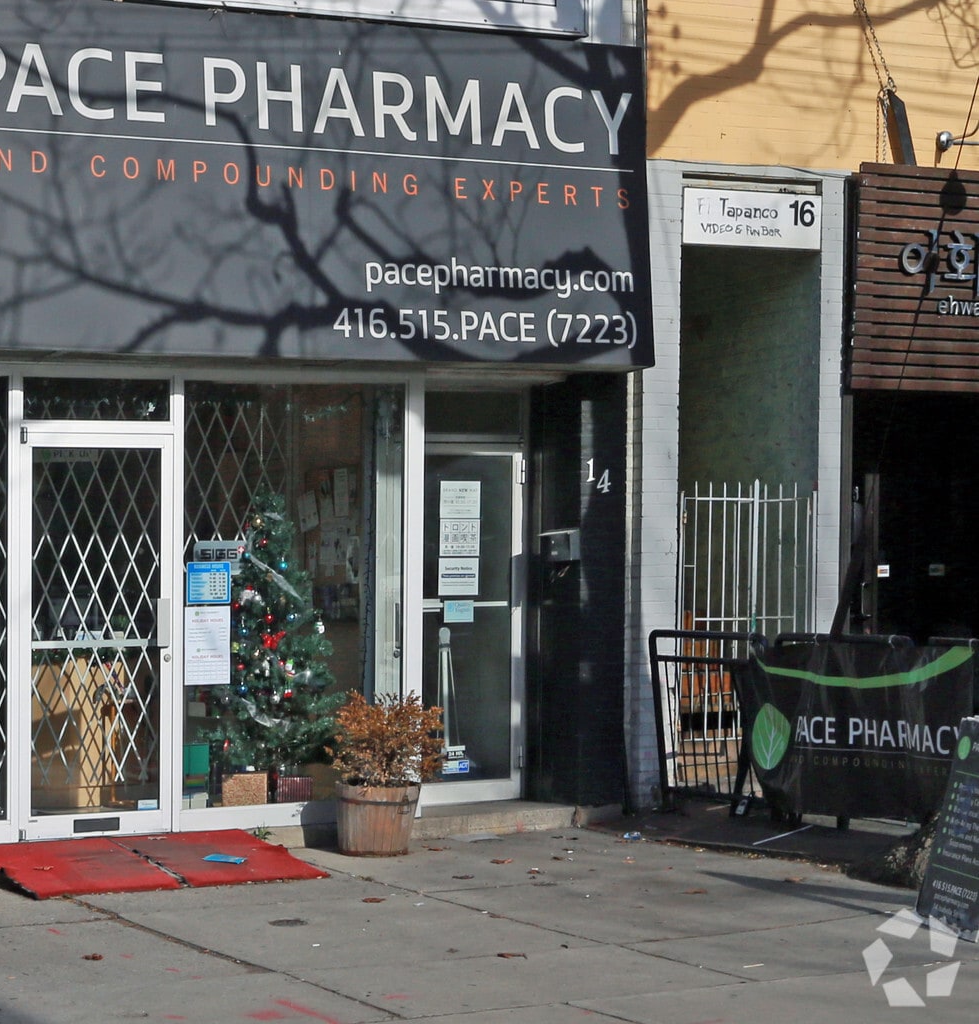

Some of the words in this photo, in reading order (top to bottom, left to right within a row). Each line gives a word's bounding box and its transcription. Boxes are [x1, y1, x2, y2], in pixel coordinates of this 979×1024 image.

[202, 56, 633, 156] PHARMACY
[90, 154, 419, 197] COMPOUNDING
[454, 177, 631, 210] EXPERTS
[700, 222, 734, 235] VIDEO
[719, 197, 779, 221] Tapanco
[788, 199, 816, 228] 16
[365, 257, 635, 299] pacepharmacy.com
[332, 307, 537, 344] 416.515.PACE
[545, 308, 638, 350] (7223)
[586, 458, 612, 494] 14
[200, 548, 238, 560] SIGG
